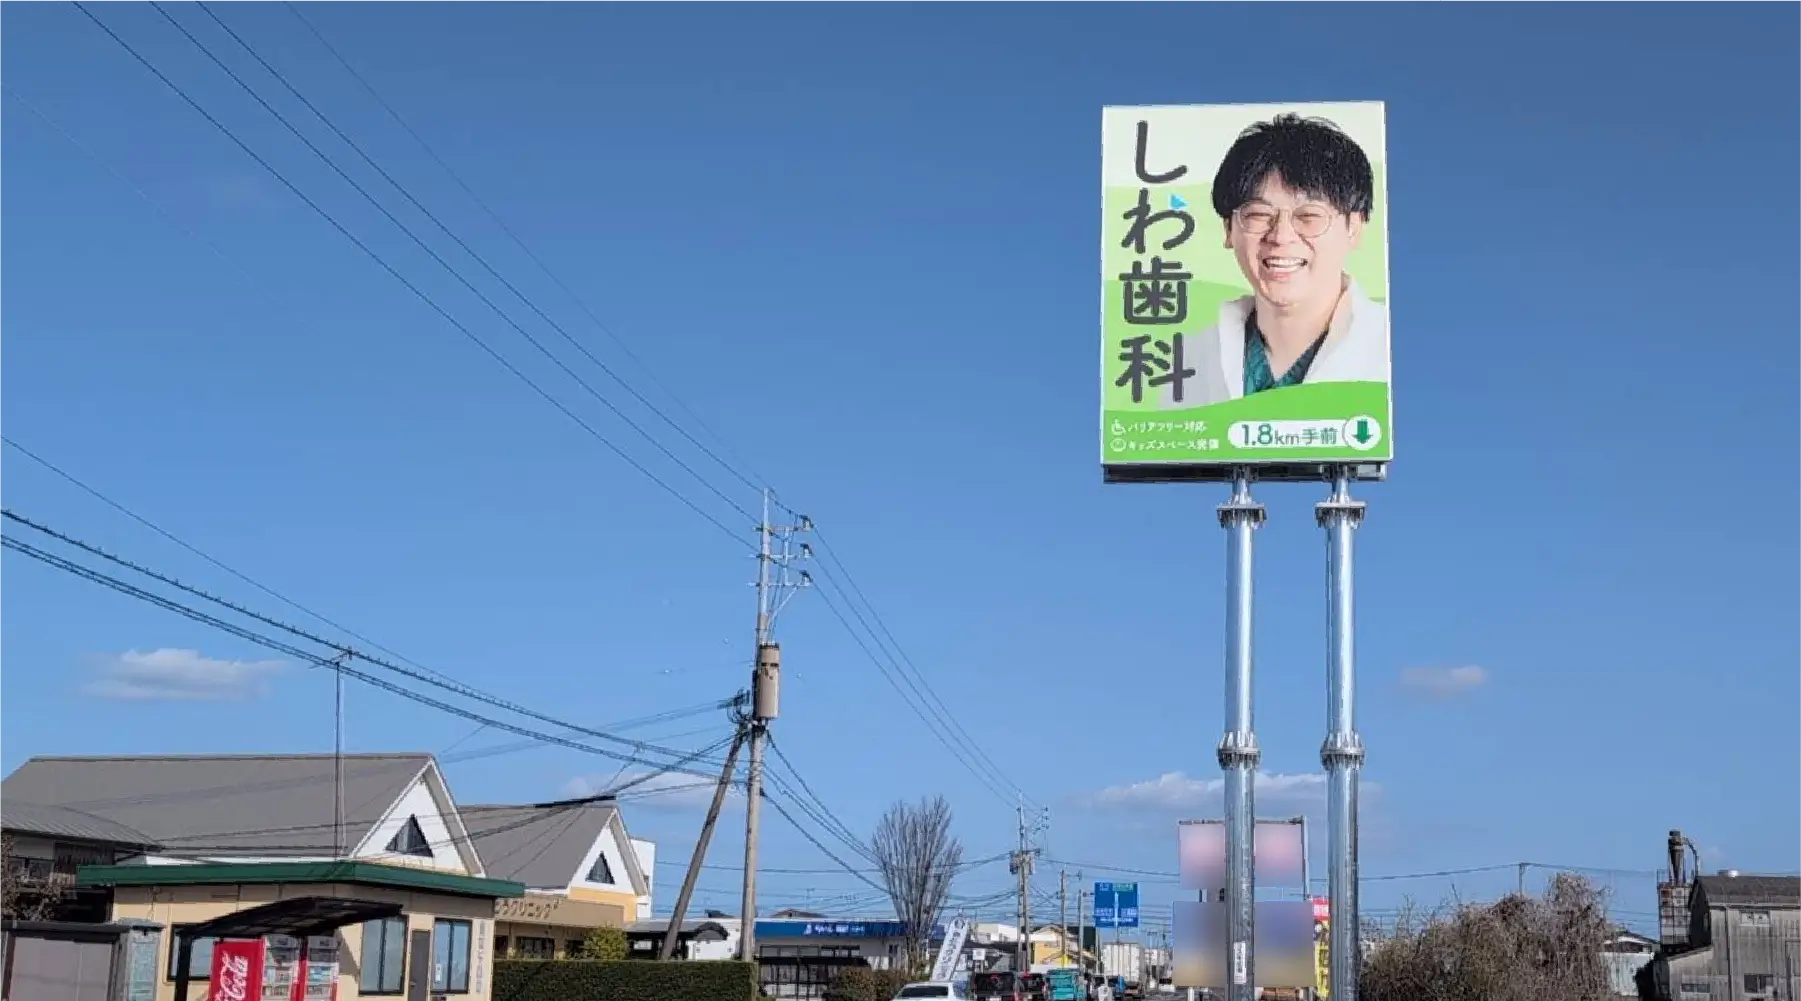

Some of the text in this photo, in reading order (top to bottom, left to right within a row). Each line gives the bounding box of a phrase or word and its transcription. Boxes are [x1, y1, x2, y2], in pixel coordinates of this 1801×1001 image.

[1115, 119, 1196, 403] しわ歯科
[1241, 423, 1339, 445] 1.8km手前
